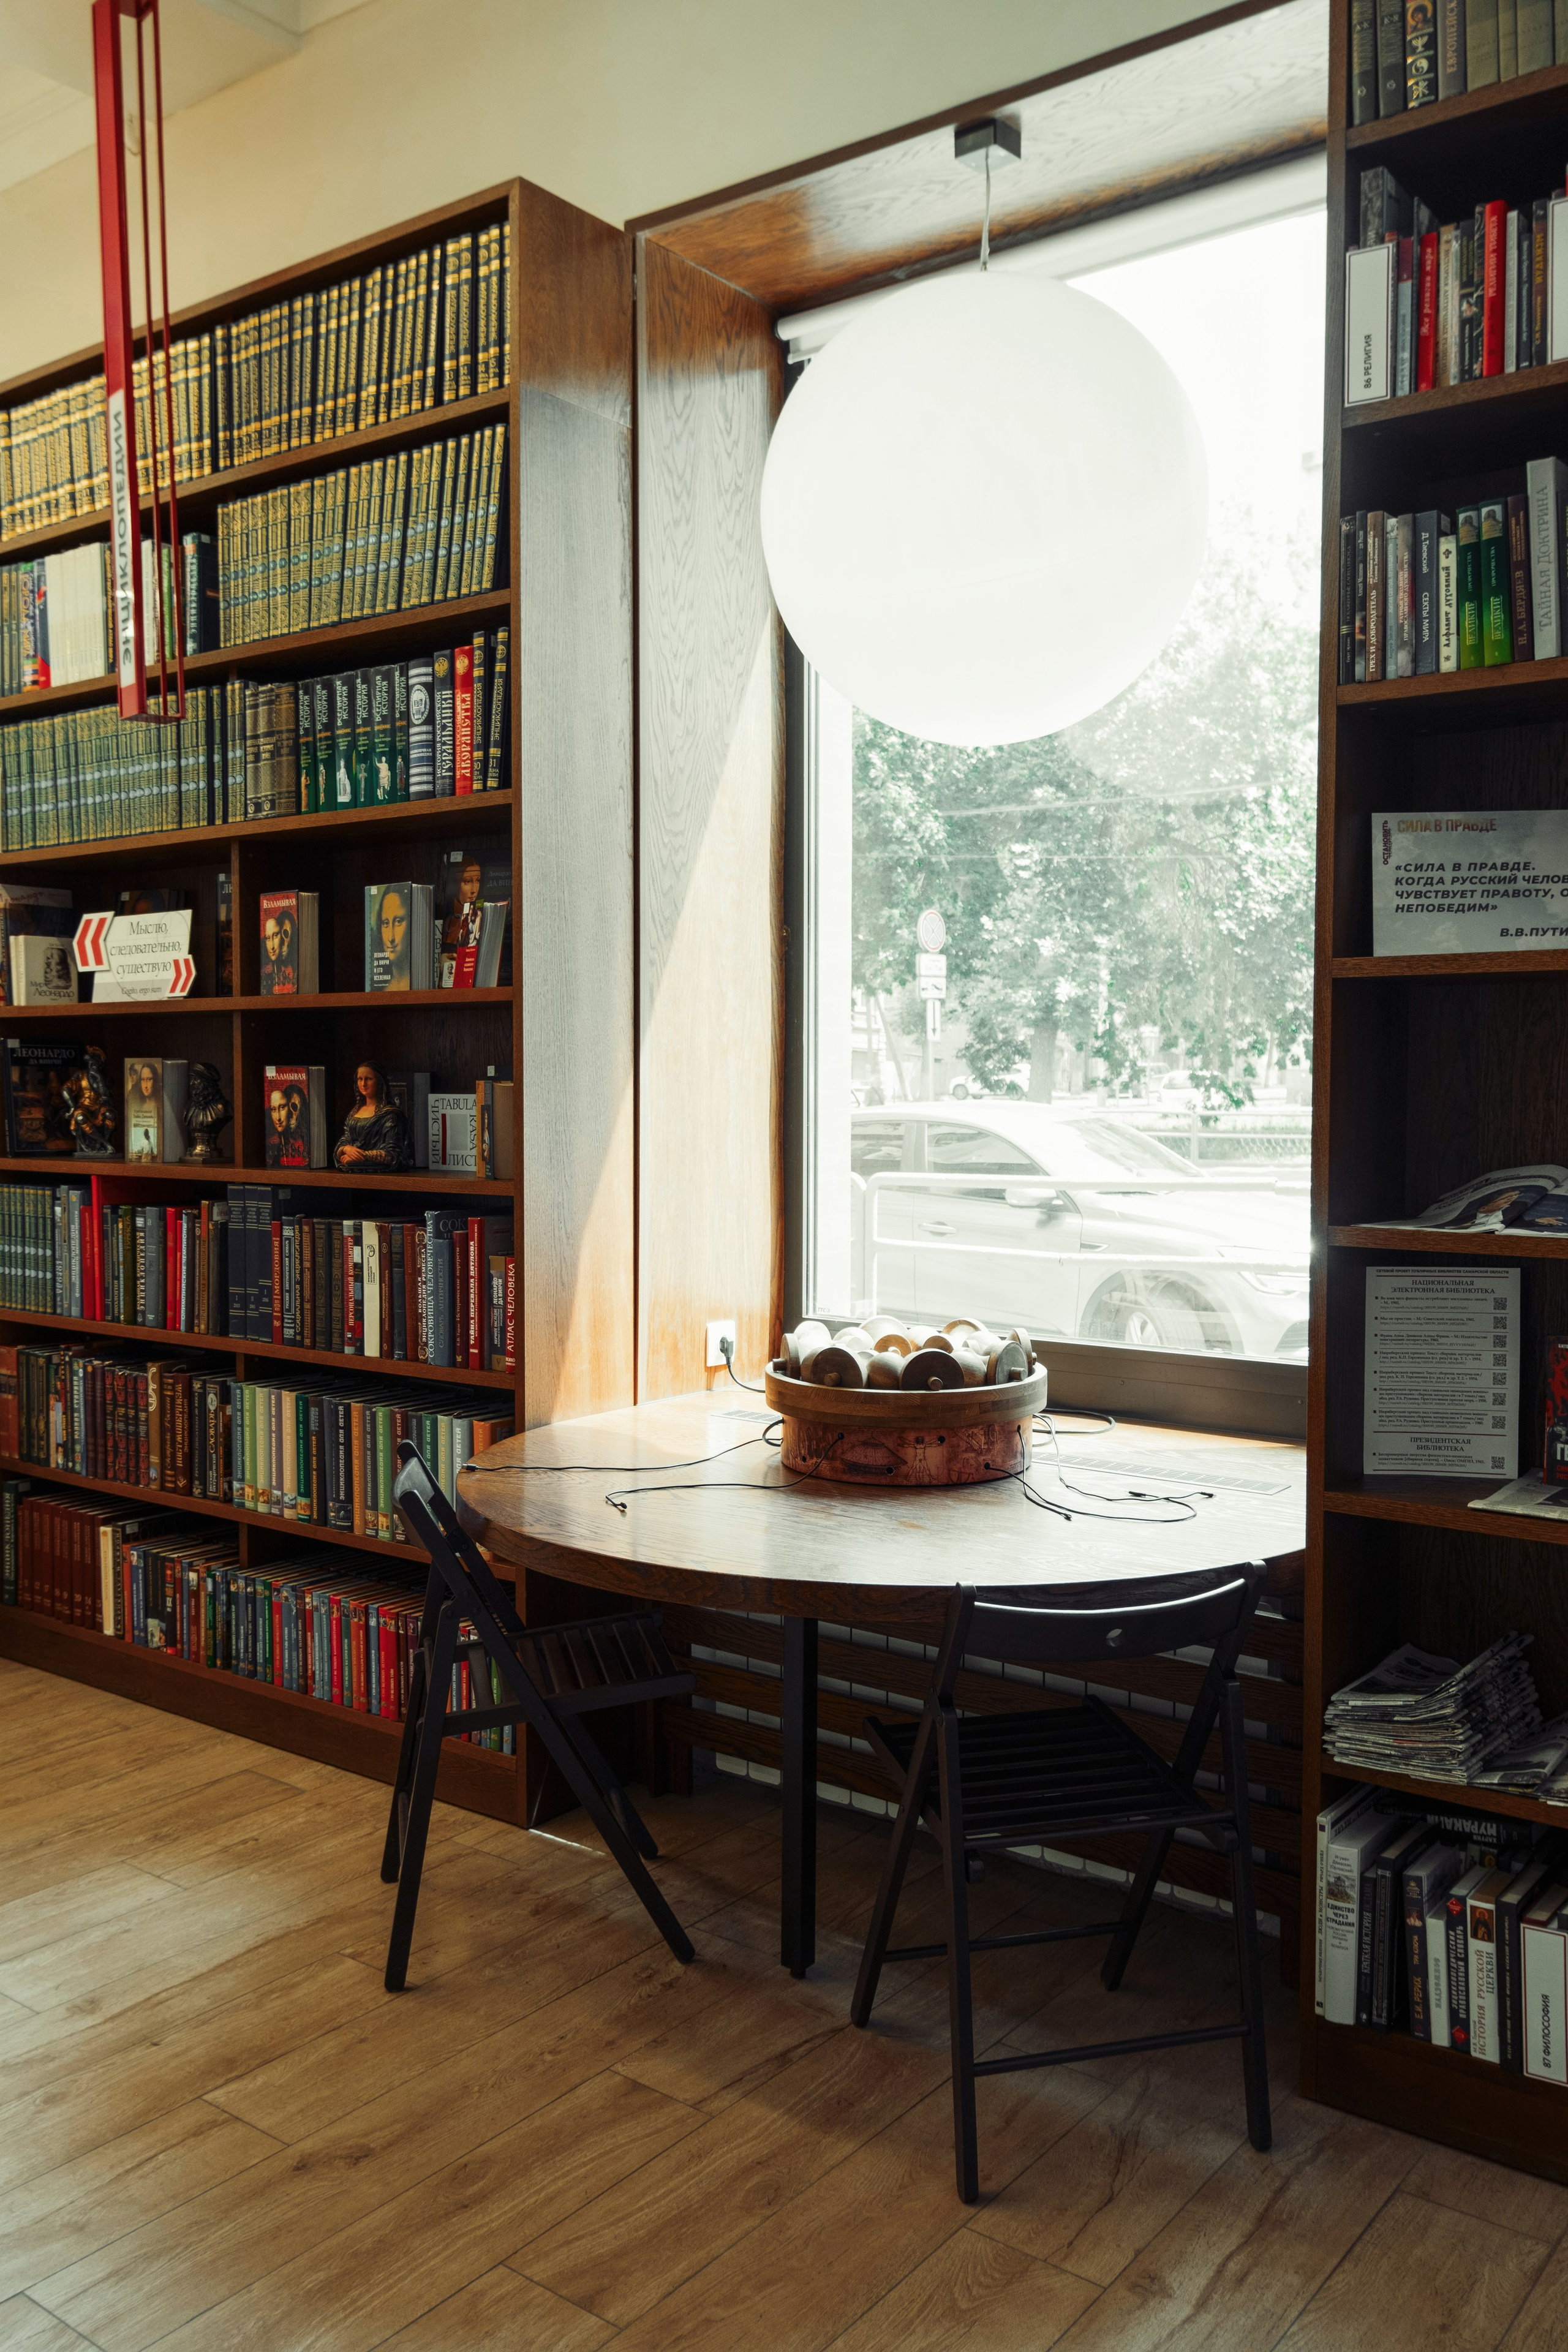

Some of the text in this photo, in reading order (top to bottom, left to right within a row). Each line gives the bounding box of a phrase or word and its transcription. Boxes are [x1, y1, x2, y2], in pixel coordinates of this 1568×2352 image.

[1364, 378, 1372, 389] 86
[112, 410, 132, 665] ЭНЦИКЛОПЕДИИ
[1515, 570, 1526, 619] БЕРДЯЕВ
[1368, 590, 1378, 644] ДОБРОДЕТЕЛЬ
[1467, 601, 1476, 644] ВЕЛИКИЕ
[1492, 595, 1502, 639] ВЕЛИКИЕ
[1517, 620, 1526, 631] А.
[1518, 633, 1527, 645] Н.
[494, 678, 503, 740] ЭНЦИКЛОПЕДИЯ
[461, 693, 470, 777] ДВОРЯНСТВА
[1397, 818, 1497, 833] СИЛА В ПРАВДЕ
[1395, 861, 1536, 873] «СИЛА В ПРАВДЕ.
[1395, 876, 1446, 887] КОГДА
[1451, 873, 1517, 885] РУССКИЙ
[1396, 889, 1477, 899] ЧУВСТВУЕТ
[1481, 888, 1554, 899] ПРАВОТУ,
[1395, 903, 1498, 913] НЕПОБЕДИМ»
[129, 921, 168, 935] Мыслю,
[110, 941, 181, 956] следовательно,
[117, 961, 172, 979] существую
[34, 989, 74, 997] Леонардо
[14, 1048, 75, 1058] ЛЕОНАРДО
[440, 1098, 477, 1110] TABULA
[431, 1098, 440, 1164] ЧИСТЫЙ
[1410, 1437, 1471, 1446] ПРЕЗИДЕНТСКАЯ
[1362, 1911, 1372, 1942] ИСТОРИЯ
[1361, 1943, 1371, 1973] КРАТКАЯ
[1413, 1976, 1422, 2002] РЕРИХ
[1474, 1949, 1486, 2056] ИСТОРИЯ РУССКОЙ
[1414, 2003, 1423, 2019] Е.И.
[1542, 1994, 1551, 2068] 87 ФИЛОСОФИЯ
